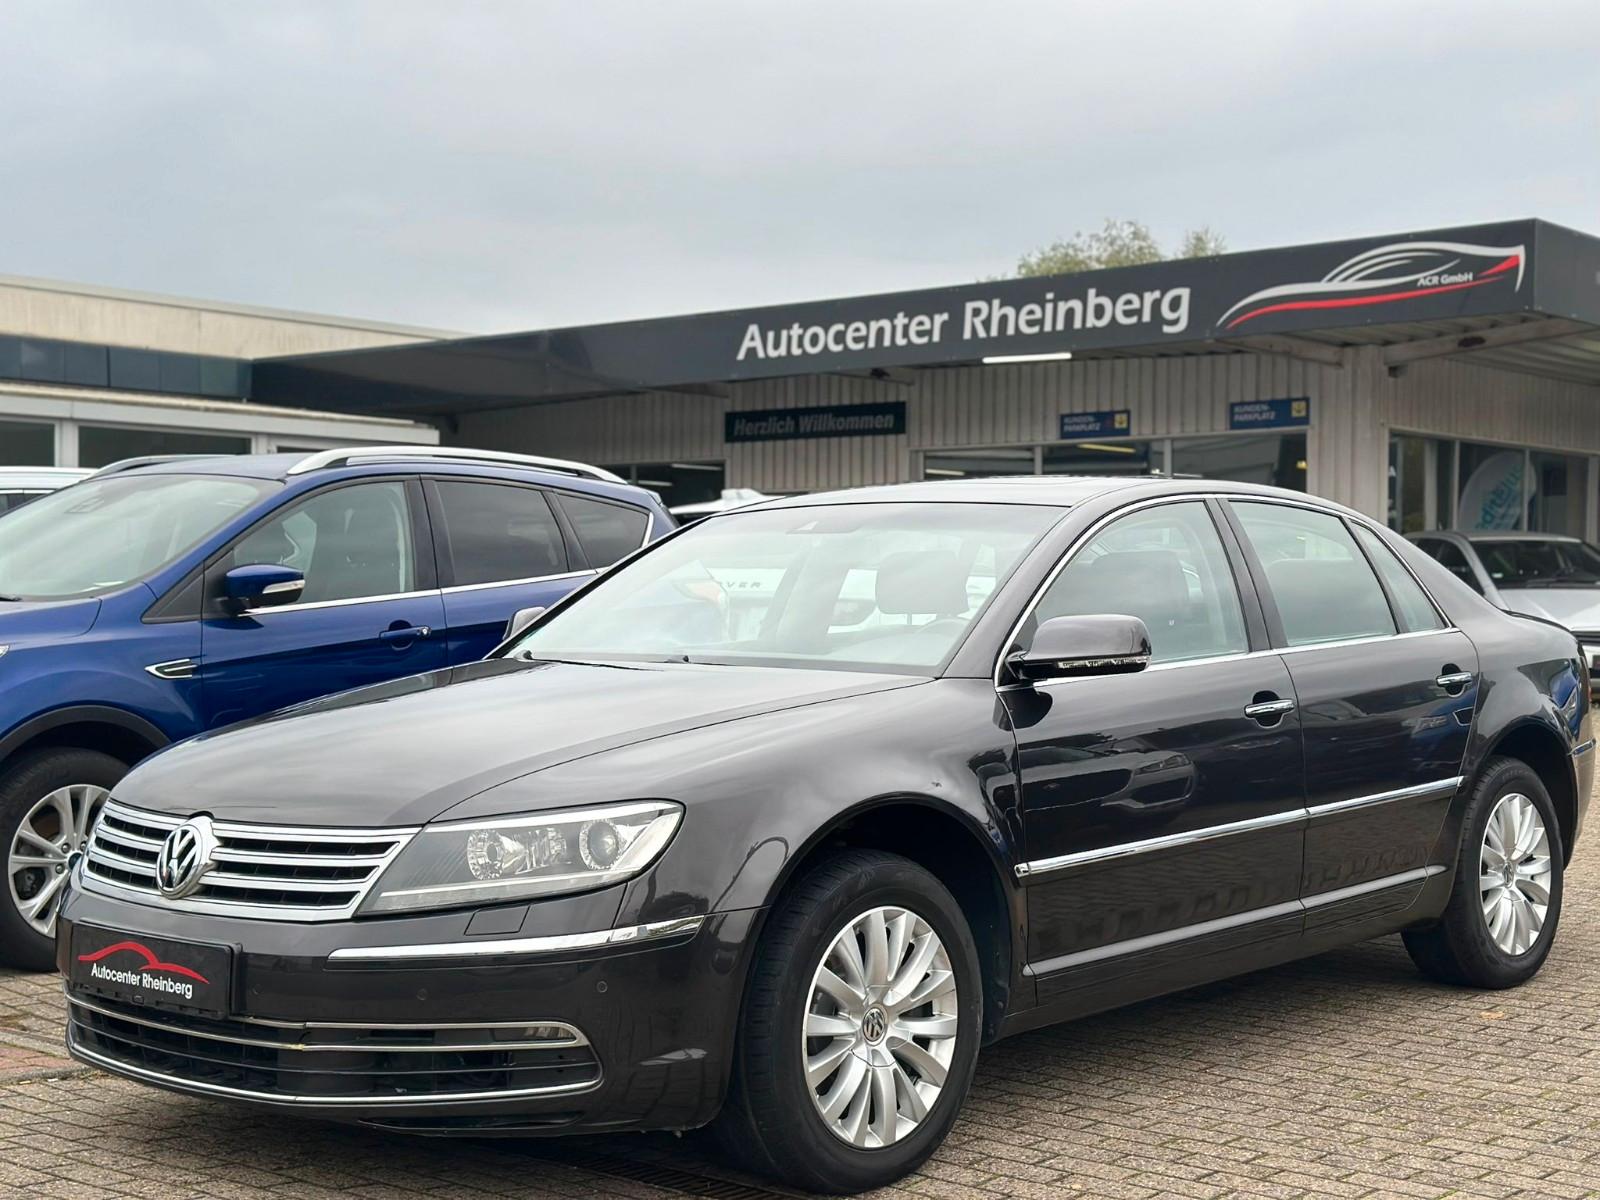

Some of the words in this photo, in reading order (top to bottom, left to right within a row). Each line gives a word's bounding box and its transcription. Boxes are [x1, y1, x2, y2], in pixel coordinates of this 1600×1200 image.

[1416, 275, 1440, 287] ACR
[1440, 272, 1473, 284] GmbH
[736, 312, 948, 361] Autocenter
[962, 286, 1191, 340] Rheinberg
[733, 415, 794, 437] Herzlich
[798, 412, 894, 433] Willkommen
[91, 962, 140, 986] Autocenter
[142, 972, 192, 999] Rheinberg
